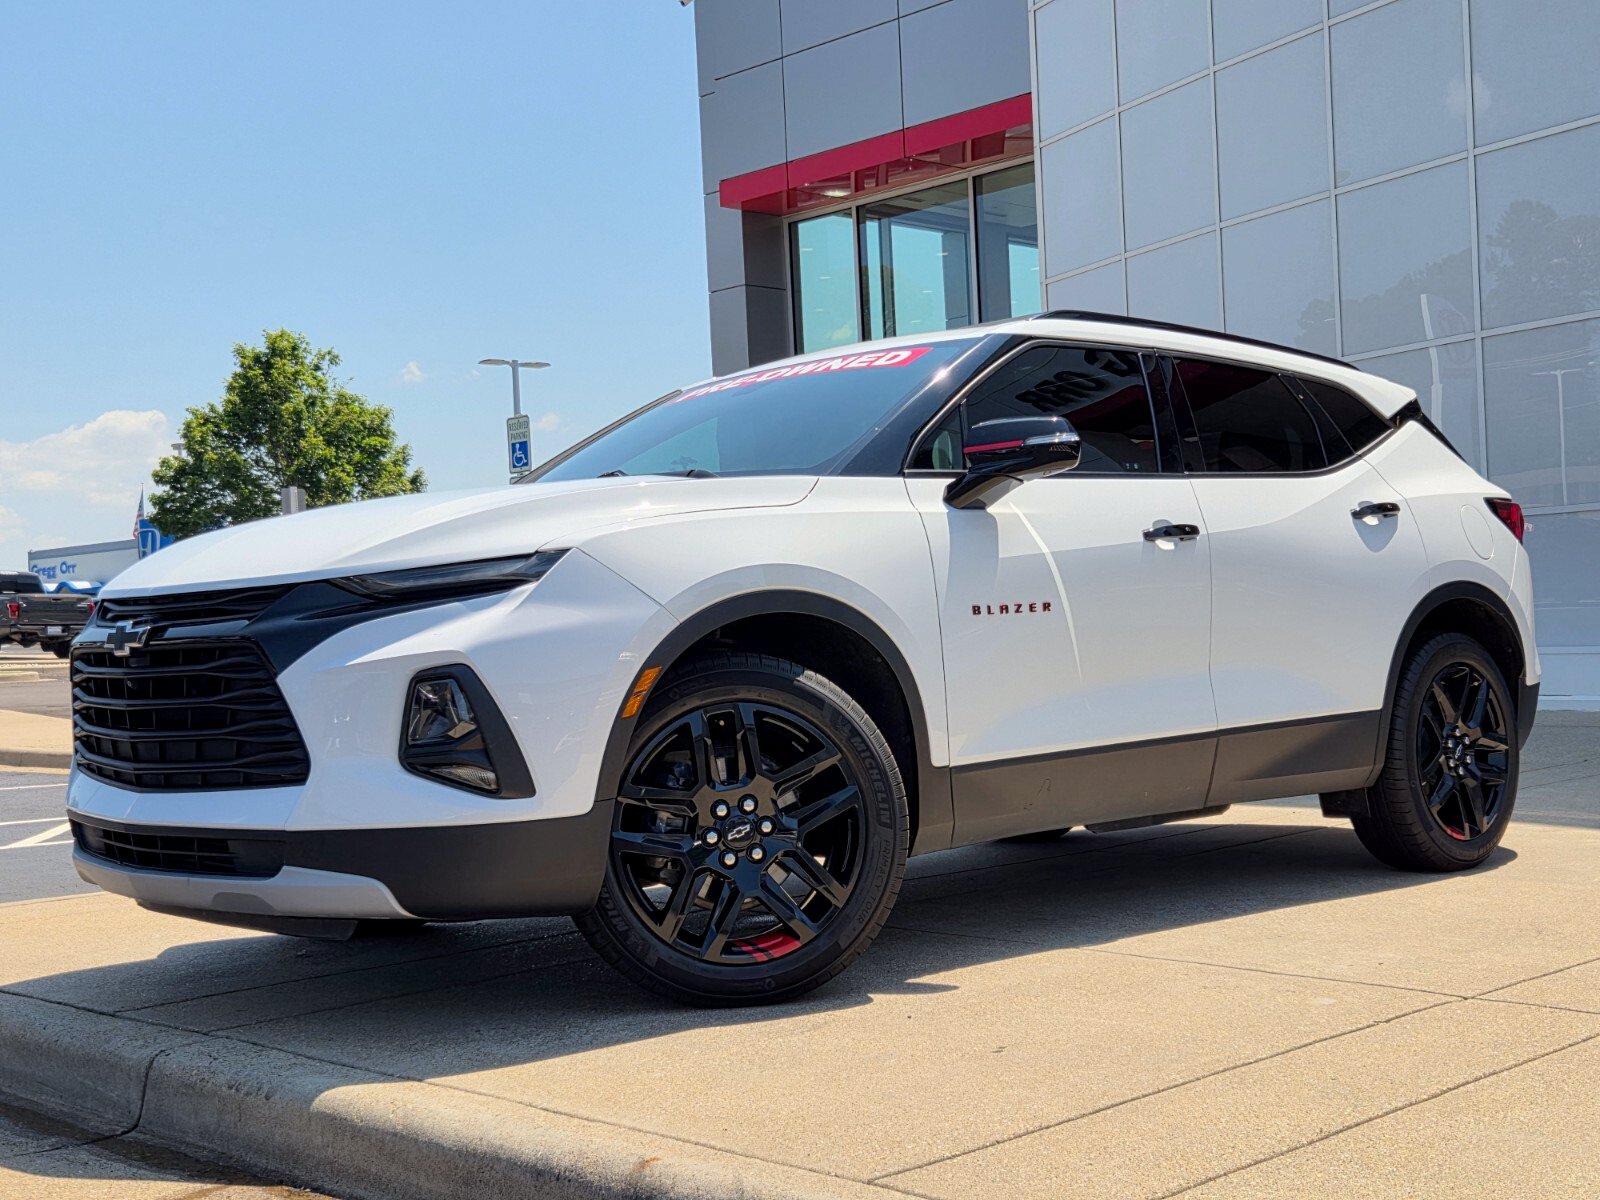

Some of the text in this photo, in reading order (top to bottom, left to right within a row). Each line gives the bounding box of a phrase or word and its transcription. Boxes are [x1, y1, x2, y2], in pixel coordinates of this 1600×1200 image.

[675, 350, 913, 403] PRE-OWNED
[510, 431, 528, 441] PARKING
[31, 561, 77, 579] Gregg Orr
[972, 602, 1051, 615] BLAZER
[850, 734, 891, 924] MICHELIN PRIMACY TOUR
